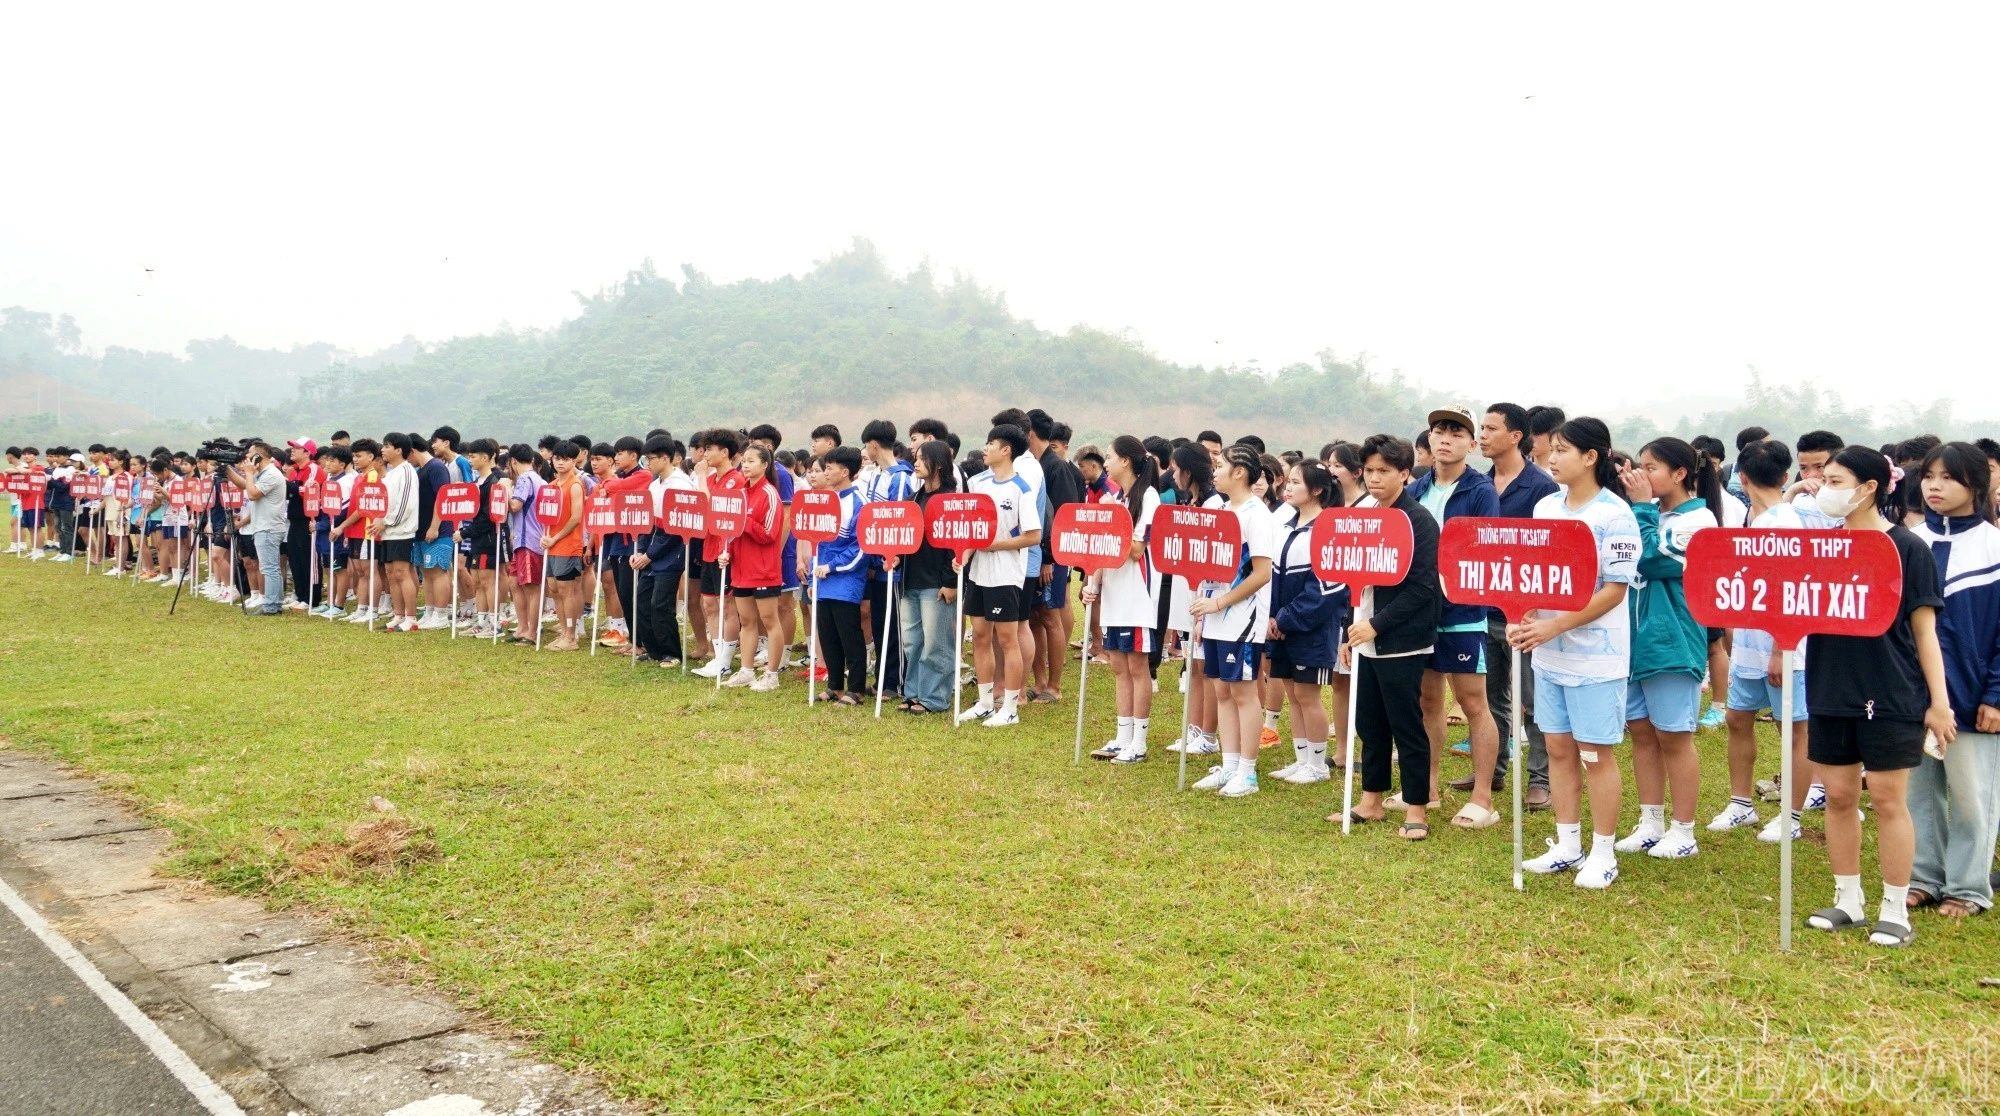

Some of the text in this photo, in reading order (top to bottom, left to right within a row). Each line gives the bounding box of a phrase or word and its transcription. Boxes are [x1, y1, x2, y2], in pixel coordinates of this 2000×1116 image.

[892, 508, 905, 518] THPT
[964, 499, 977, 510] THPT
[620, 507, 628, 526] SỐ
[628, 510, 631, 526] 1
[669, 506, 677, 526] SỐ
[678, 512, 682, 527] 2
[796, 508, 803, 530] SỐ
[803, 513, 807, 530] 2
[933, 514, 988, 539] SỐ 2 BẢO YÊN
[1200, 513, 1216, 528] THPT
[1364, 518, 1382, 534] THPT
[866, 521, 914, 546] SỐ 1 BÁT XÁT
[1059, 528, 1121, 557] MƯỜNG KHƯƠNG
[1164, 532, 1234, 567] NỘI TRÚ TỈNH
[1321, 536, 1398, 574] SỐ 3 BẢO THẮNG
[1810, 538, 1852, 558] THPT
[1458, 557, 1572, 596] THỊ XÃ SA PA
[1716, 566, 1869, 620] SỐ 2 BÁT XÁT
